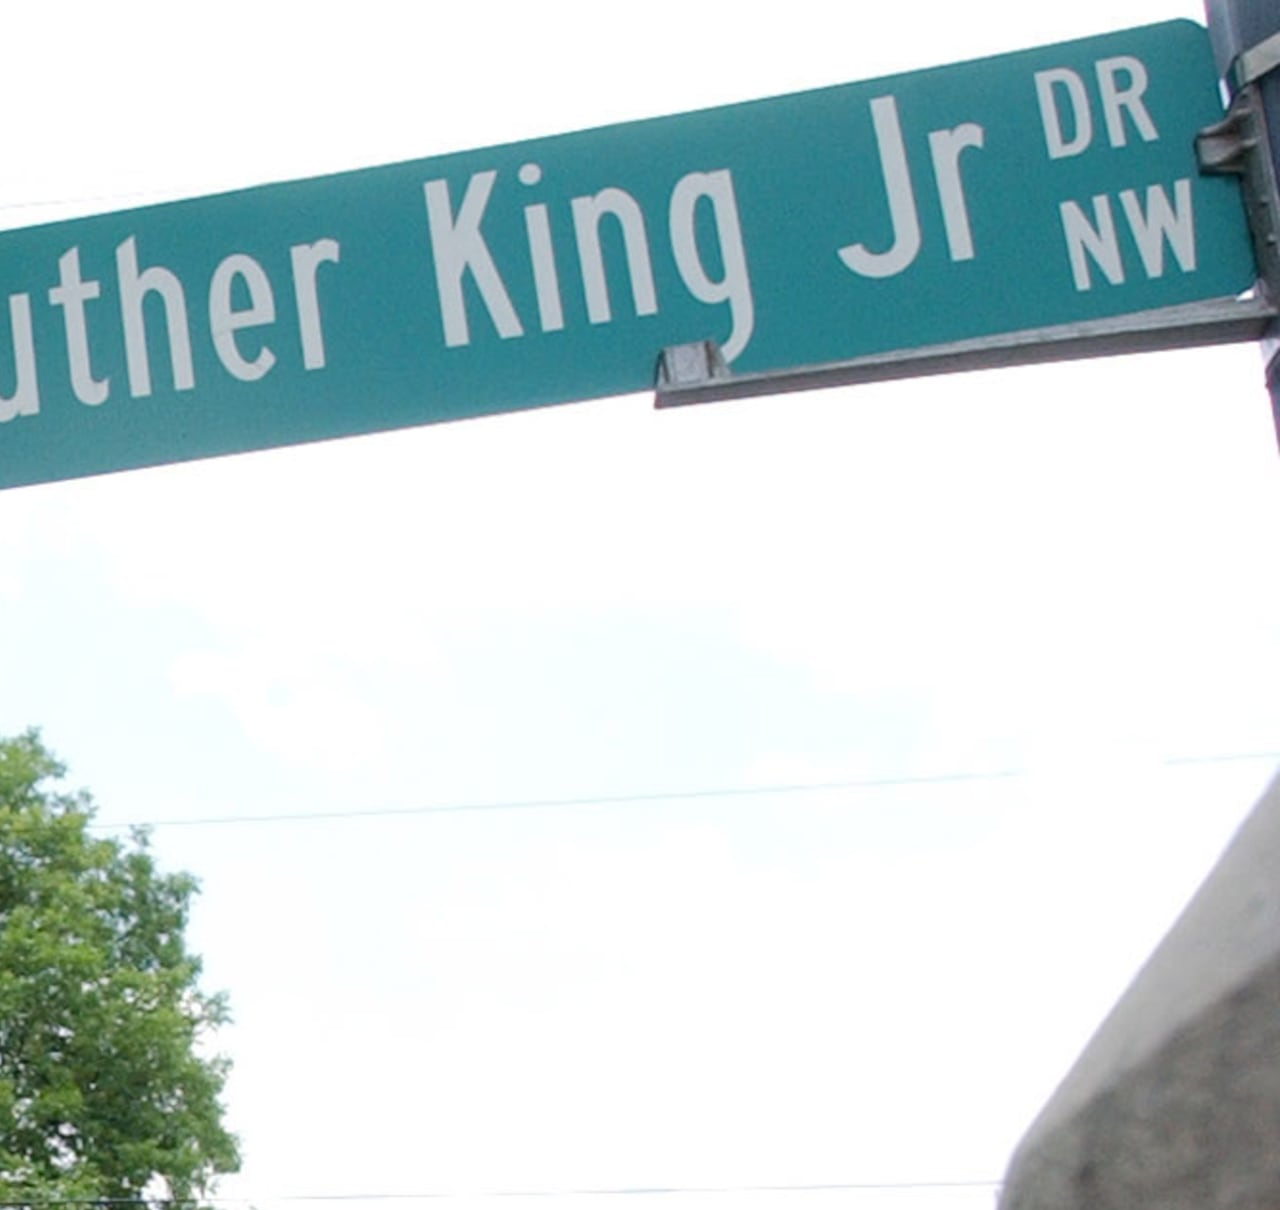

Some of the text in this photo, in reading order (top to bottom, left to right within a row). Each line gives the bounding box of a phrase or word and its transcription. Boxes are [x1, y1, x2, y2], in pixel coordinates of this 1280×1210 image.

[1034, 55, 1159, 160] DR
[424, 163, 755, 364] King
[838, 96, 985, 279] Jr
[1060, 179, 1197, 292] NW
